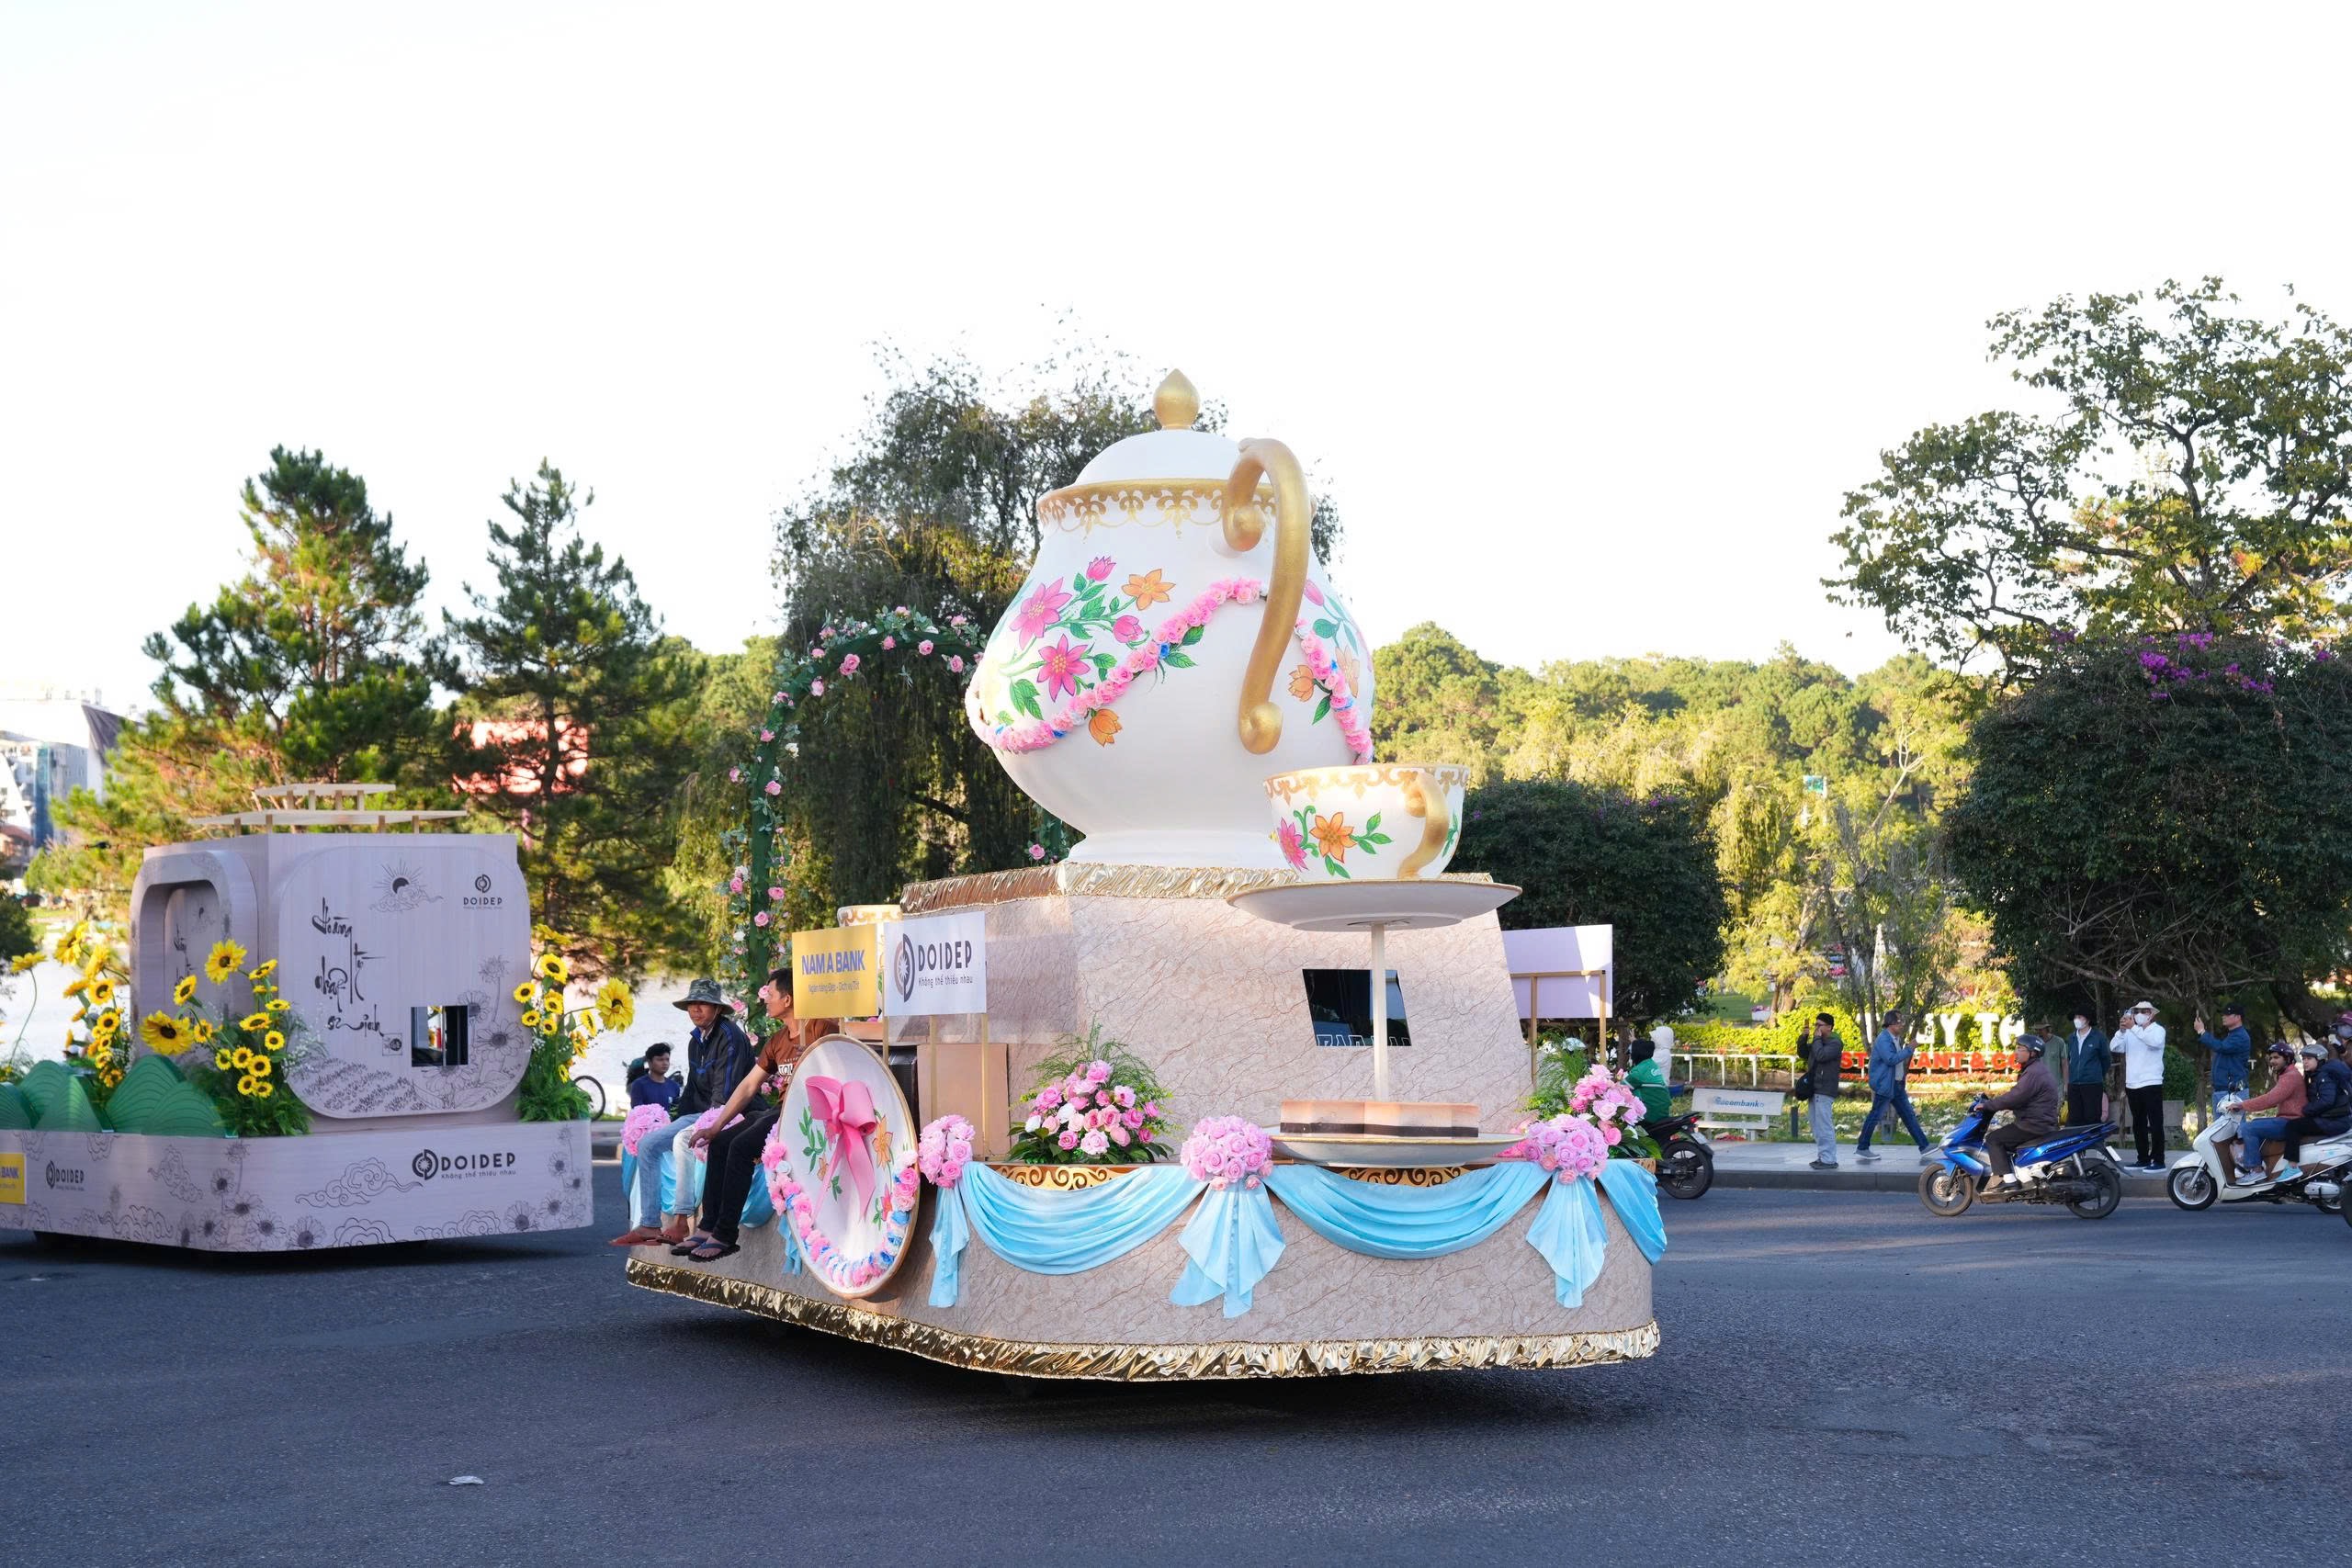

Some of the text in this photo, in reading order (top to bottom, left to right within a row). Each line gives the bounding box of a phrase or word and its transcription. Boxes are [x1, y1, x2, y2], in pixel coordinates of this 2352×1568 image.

[463, 897, 503, 906] DOIDEP
[802, 953, 825, 975] NAM
[836, 949, 865, 973] BANK
[918, 940, 972, 972] DOIDEP
[441, 1152, 515, 1171] DOIDEP
[56, 1168, 85, 1184] DOIDEP
